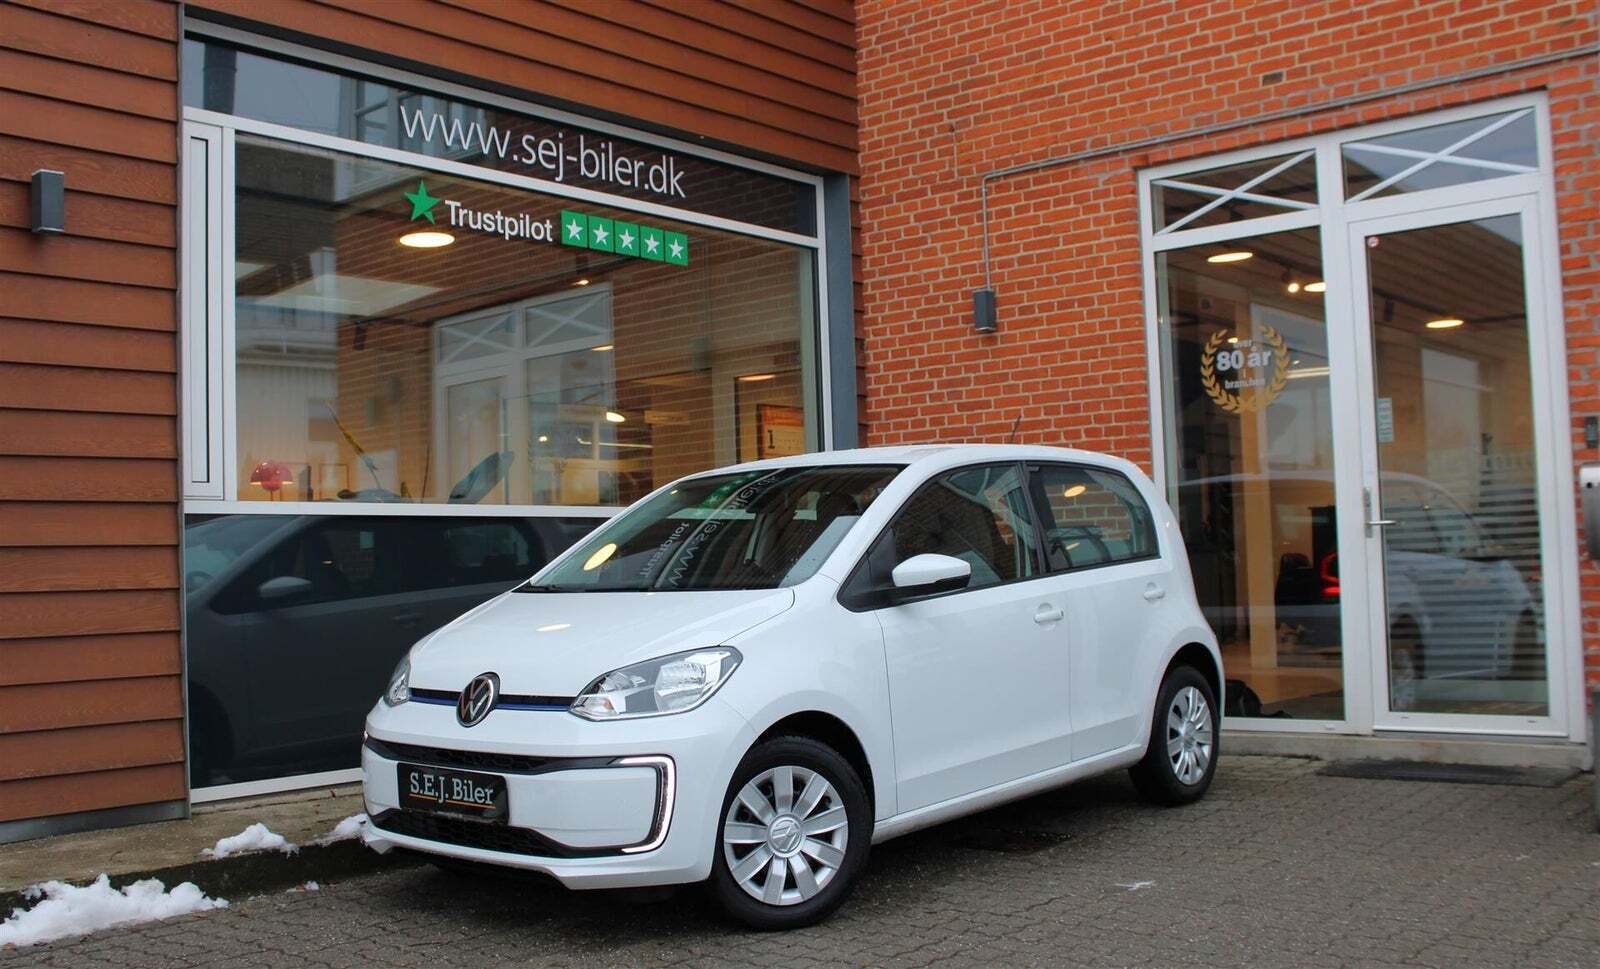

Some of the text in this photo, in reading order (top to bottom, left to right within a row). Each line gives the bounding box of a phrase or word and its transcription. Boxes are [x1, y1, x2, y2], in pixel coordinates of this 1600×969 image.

[400, 105, 686, 198] www.sej-biler.dk
[445, 199, 553, 242] Trustpilot
[1216, 345, 1272, 371] 80 år
[409, 771, 495, 805] S.E.J. Biler
